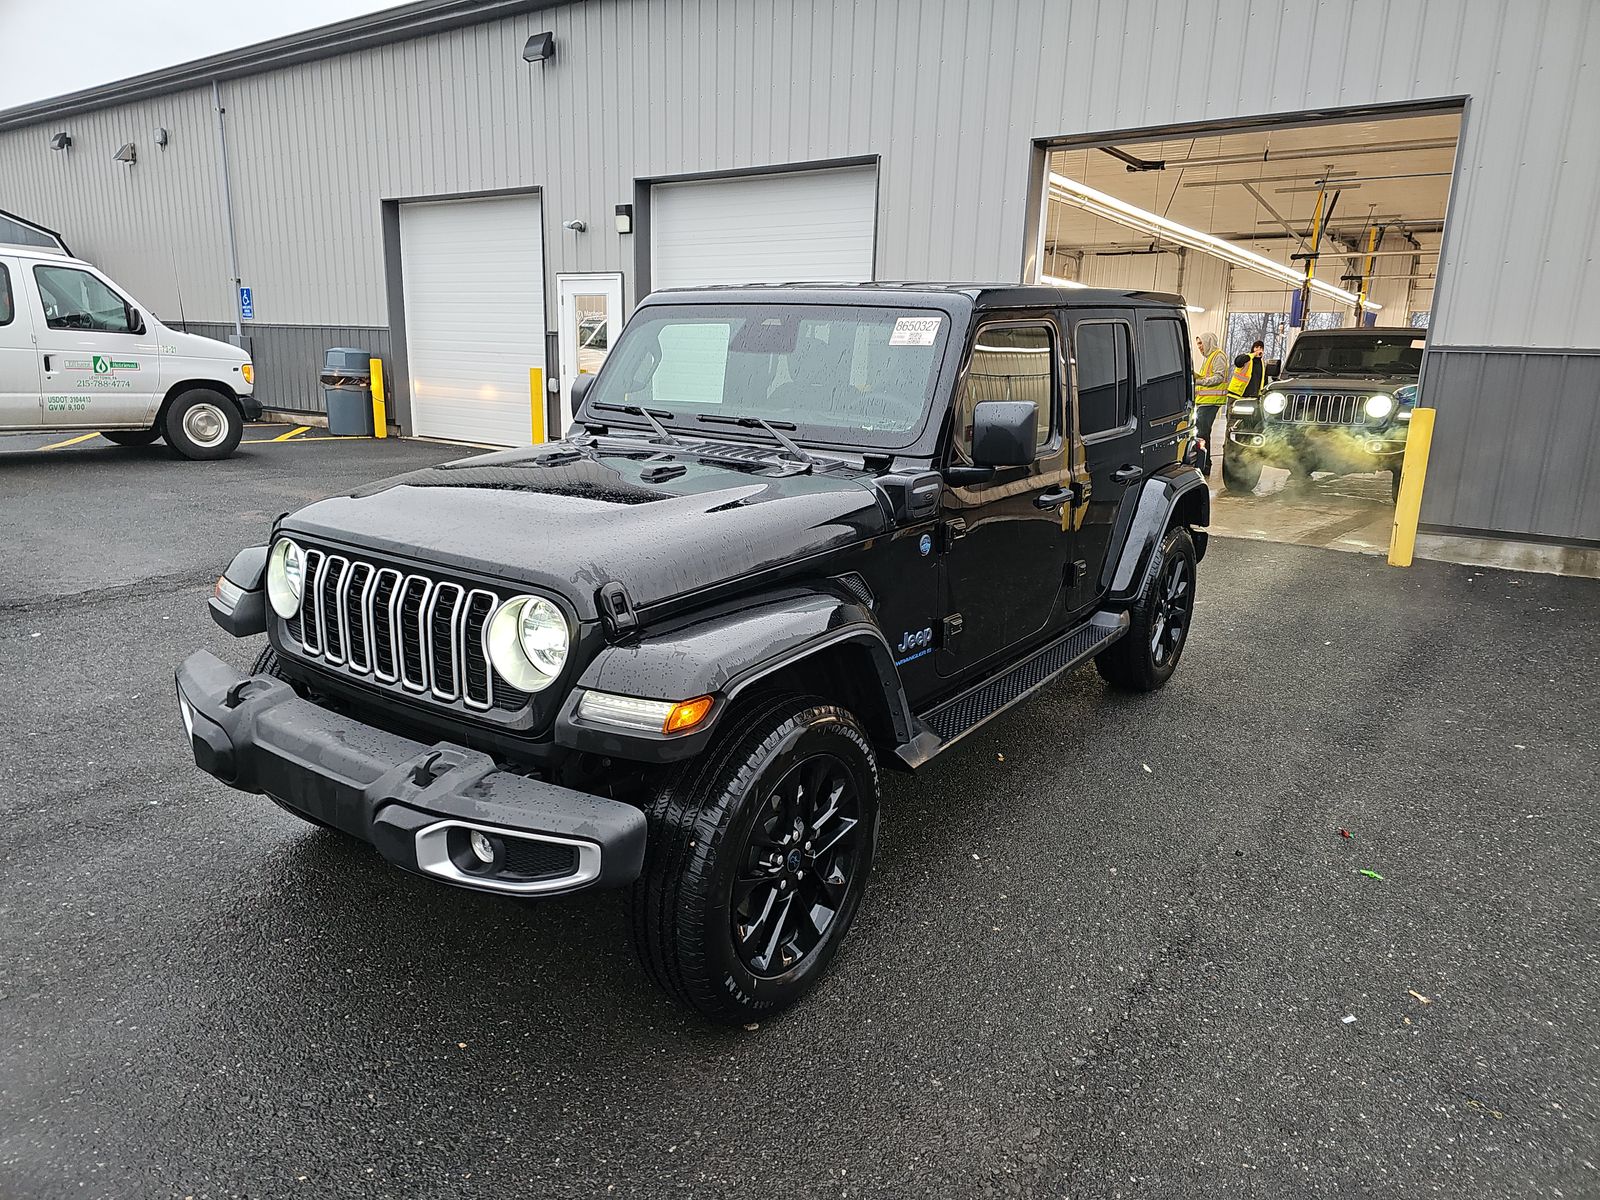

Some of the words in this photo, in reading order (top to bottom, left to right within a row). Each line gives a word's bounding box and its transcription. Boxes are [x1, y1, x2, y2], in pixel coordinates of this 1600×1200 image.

[896, 320, 940, 331] 8650327
[76, 380, 131, 388] 215-788-4774
[48, 395, 68, 404] USDOT
[897, 627, 933, 653] Jeep
